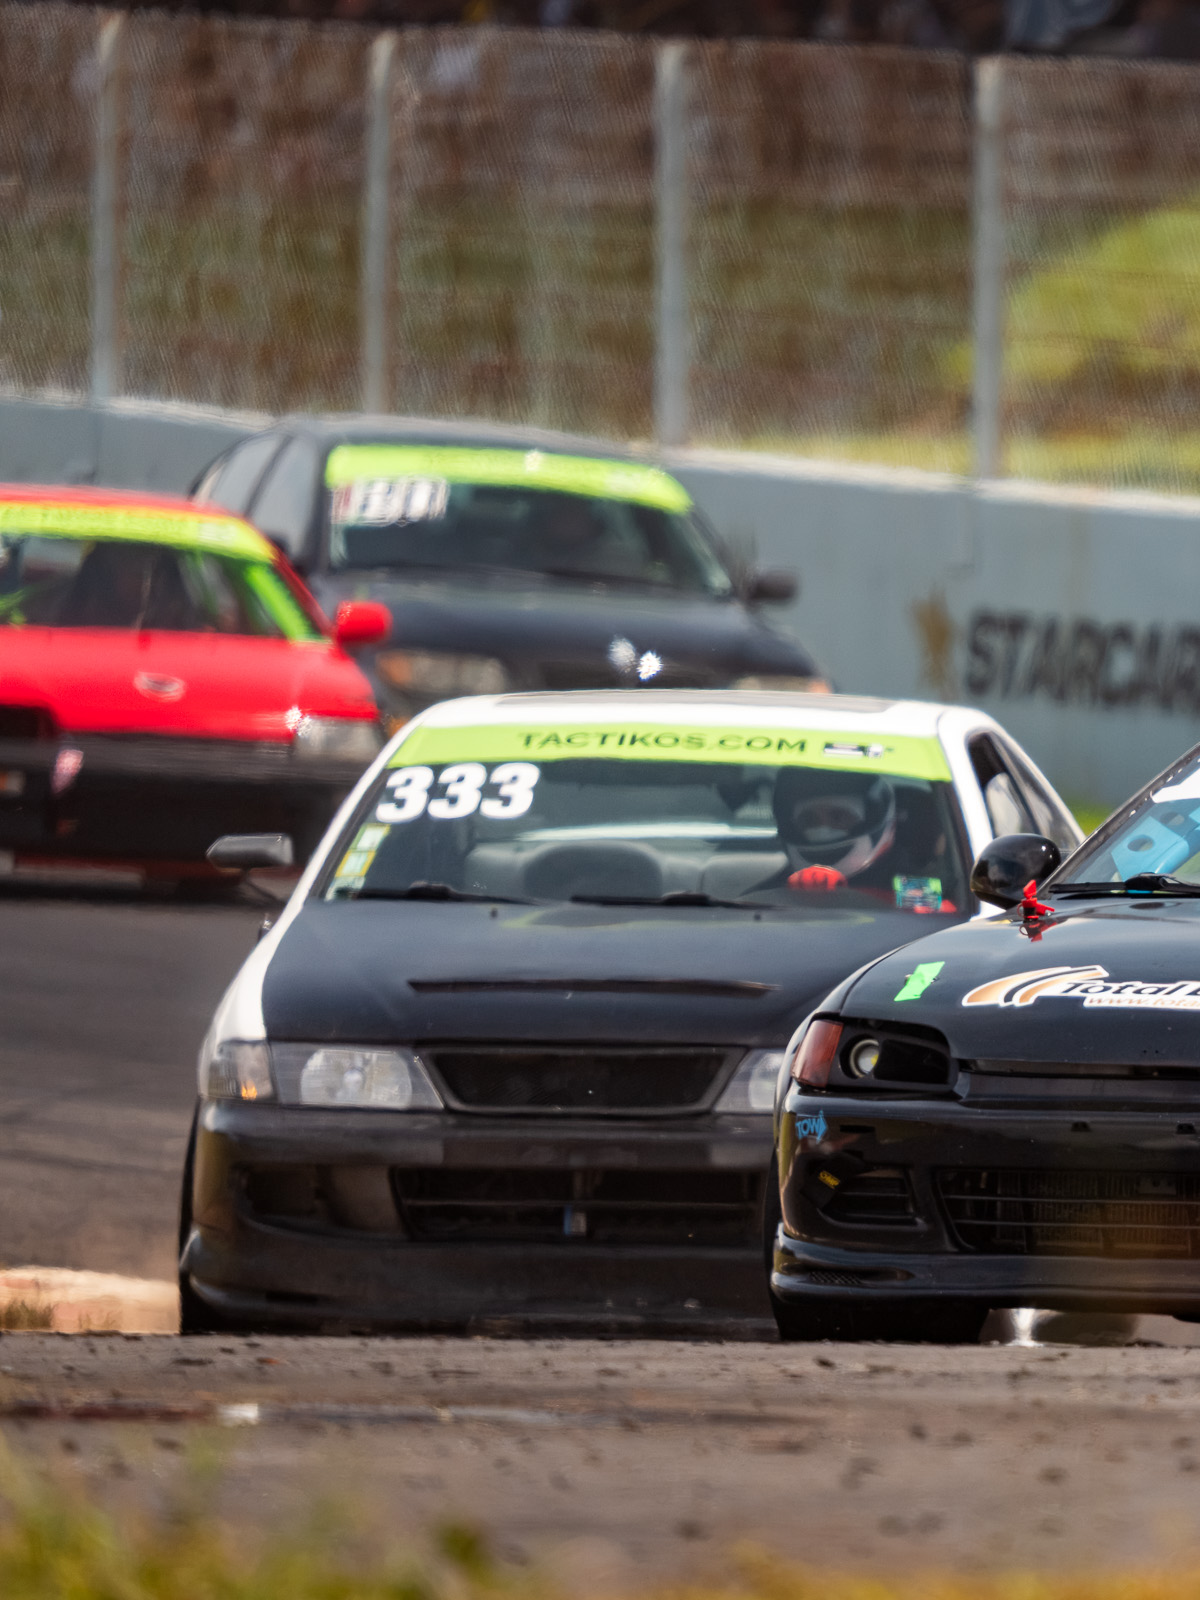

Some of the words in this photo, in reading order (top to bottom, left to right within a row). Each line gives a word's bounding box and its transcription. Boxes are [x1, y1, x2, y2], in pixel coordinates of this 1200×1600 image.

[517, 731, 808, 753] TACTIKOS.COM
[375, 762, 541, 823] 333
[1060, 981, 1190, 997] Total
